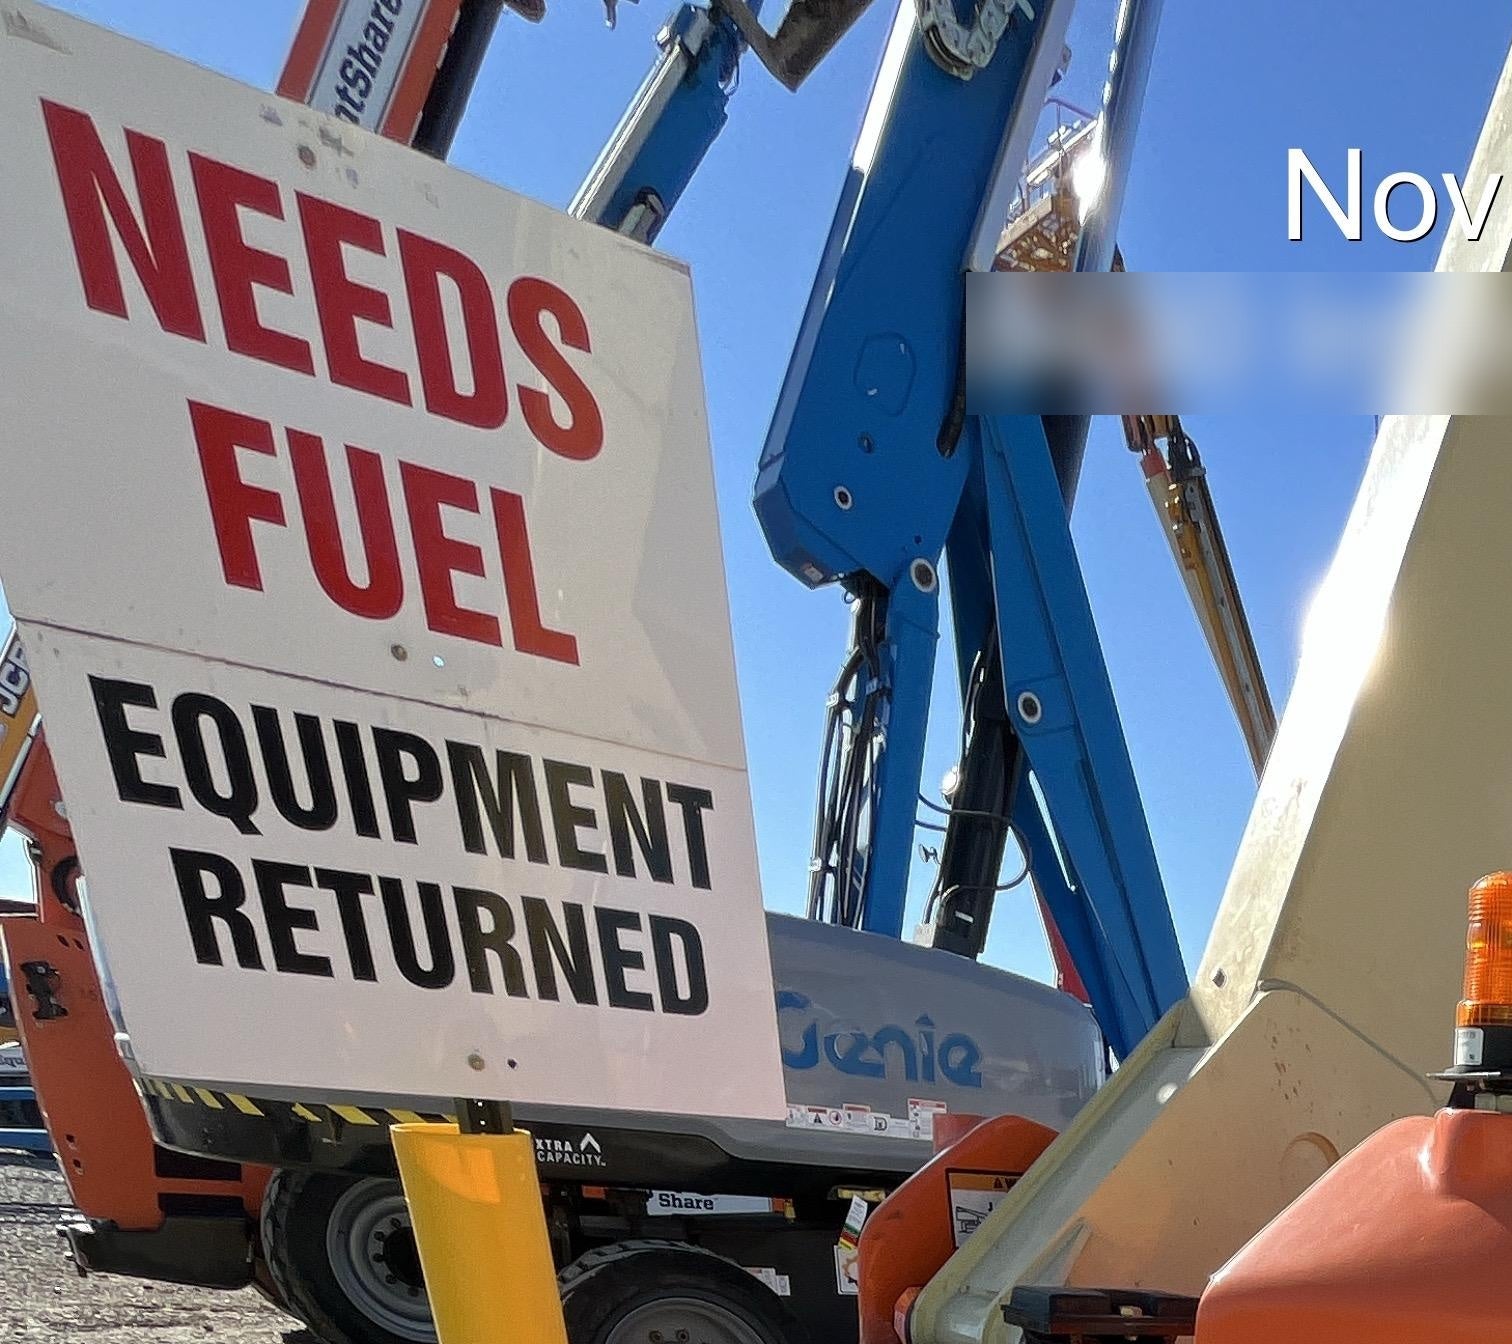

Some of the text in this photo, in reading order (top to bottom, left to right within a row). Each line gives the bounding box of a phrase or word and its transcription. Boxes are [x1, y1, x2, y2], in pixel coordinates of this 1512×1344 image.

[40, 97, 605, 462] NEEDS
[187, 398, 581, 666] FUEL
[88, 674, 714, 891] EQUIPMENT
[170, 847, 711, 1017] RETURNED
[535, 1138, 573, 1153] XTRA
[537, 1151, 602, 1167] CAPACITY
[659, 1193, 714, 1211] Share
